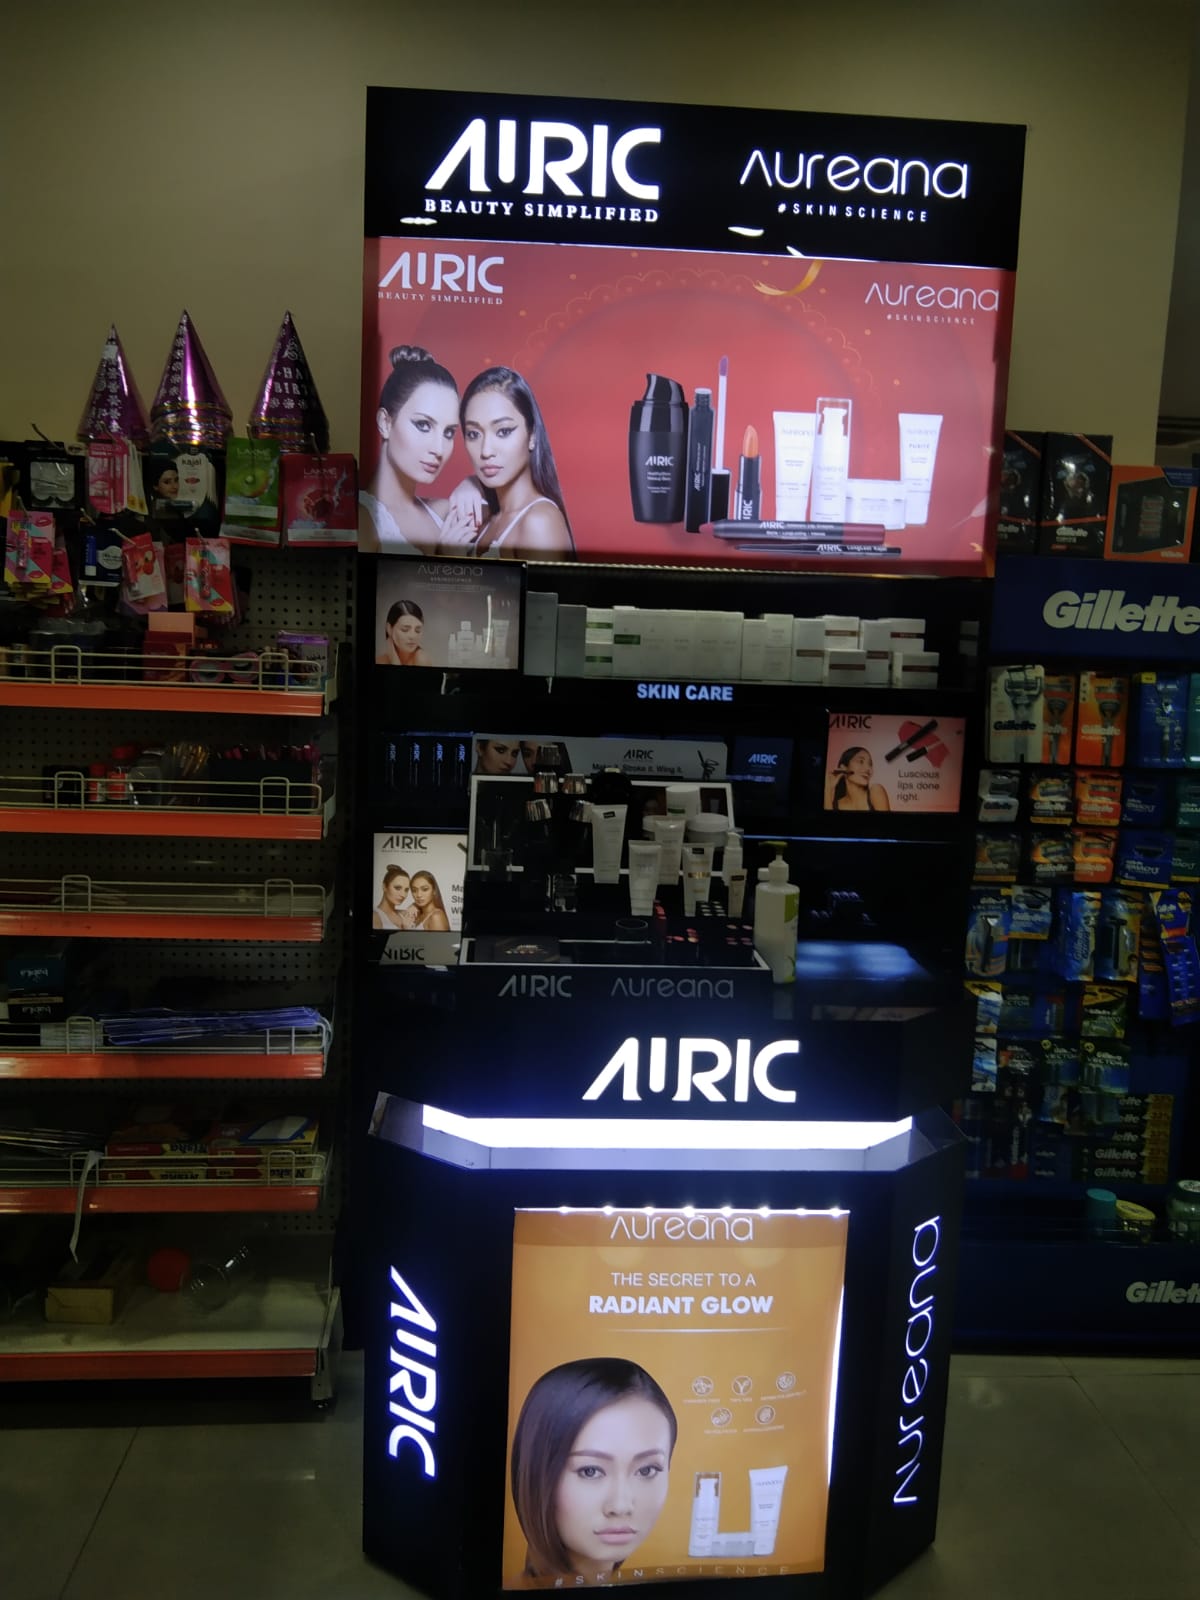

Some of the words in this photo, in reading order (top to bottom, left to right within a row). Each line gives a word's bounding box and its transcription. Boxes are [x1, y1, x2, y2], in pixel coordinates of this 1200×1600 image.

[740, 150, 968, 199] Aureana
[425, 199, 514, 215] BEAUTY
[524, 203, 659, 222] SIMPLIFIED
[378, 291, 425, 301] BEAUTY
[431, 294, 503, 305] SIMPLIFIED
[864, 282, 1000, 312] Aureana
[1042, 589, 1200, 635] Gillette
[636, 683, 680, 700] SKIN
[685, 684, 734, 702] CARE
[898, 769, 940, 779] Luscious
[898, 781, 913, 791] lips
[916, 781, 940, 791] done
[611, 977, 734, 999] Aureana
[610, 1215, 753, 1241] Aureana
[611, 1272, 643, 1286] THE
[648, 1272, 714, 1287] SECRET
[719, 1272, 741, 1287] TO
[745, 1272, 757, 1287] A
[589, 1294, 695, 1315] RADIANT
[701, 1295, 774, 1314] GLOW
[893, 1215, 941, 1503] Aureana
